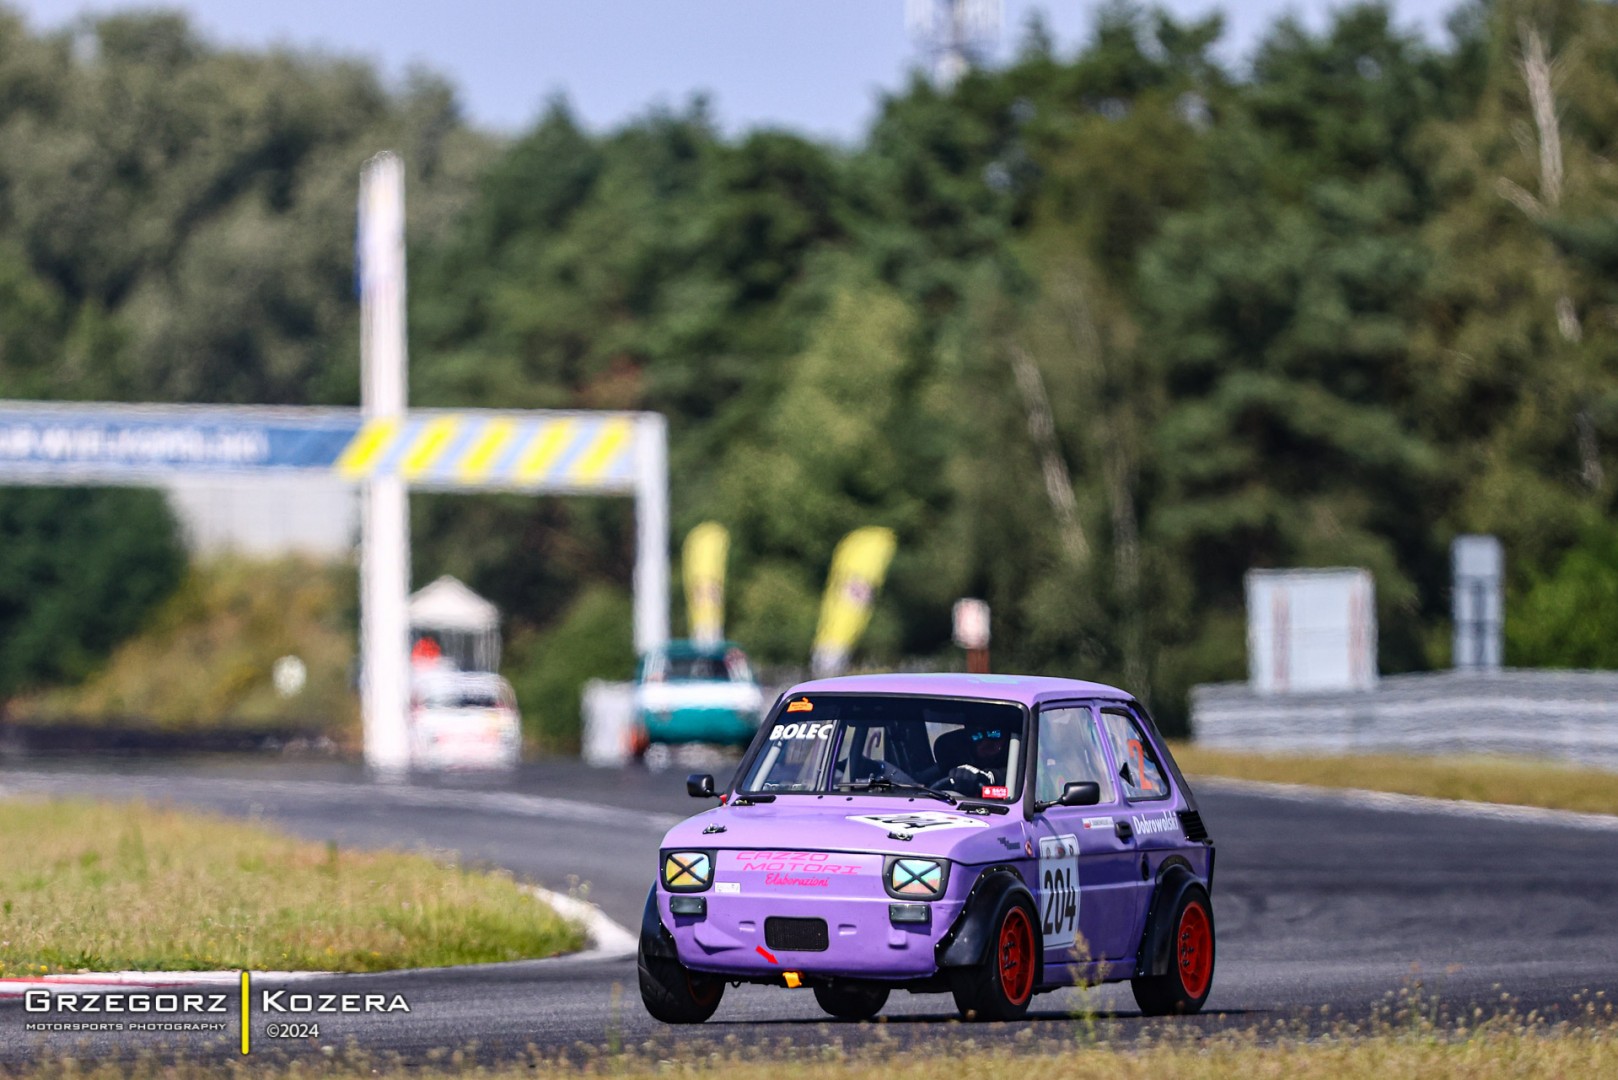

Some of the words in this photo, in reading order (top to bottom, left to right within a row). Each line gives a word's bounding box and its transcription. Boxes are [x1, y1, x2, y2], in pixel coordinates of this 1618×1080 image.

[769, 723, 834, 741] BOLEC
[1132, 810, 1180, 835] Dobrowolski
[736, 851, 830, 862] CAZZO
[743, 862, 862, 875] MOTORI
[765, 872, 830, 887] Elaborazioni
[1042, 867, 1077, 936] 204
